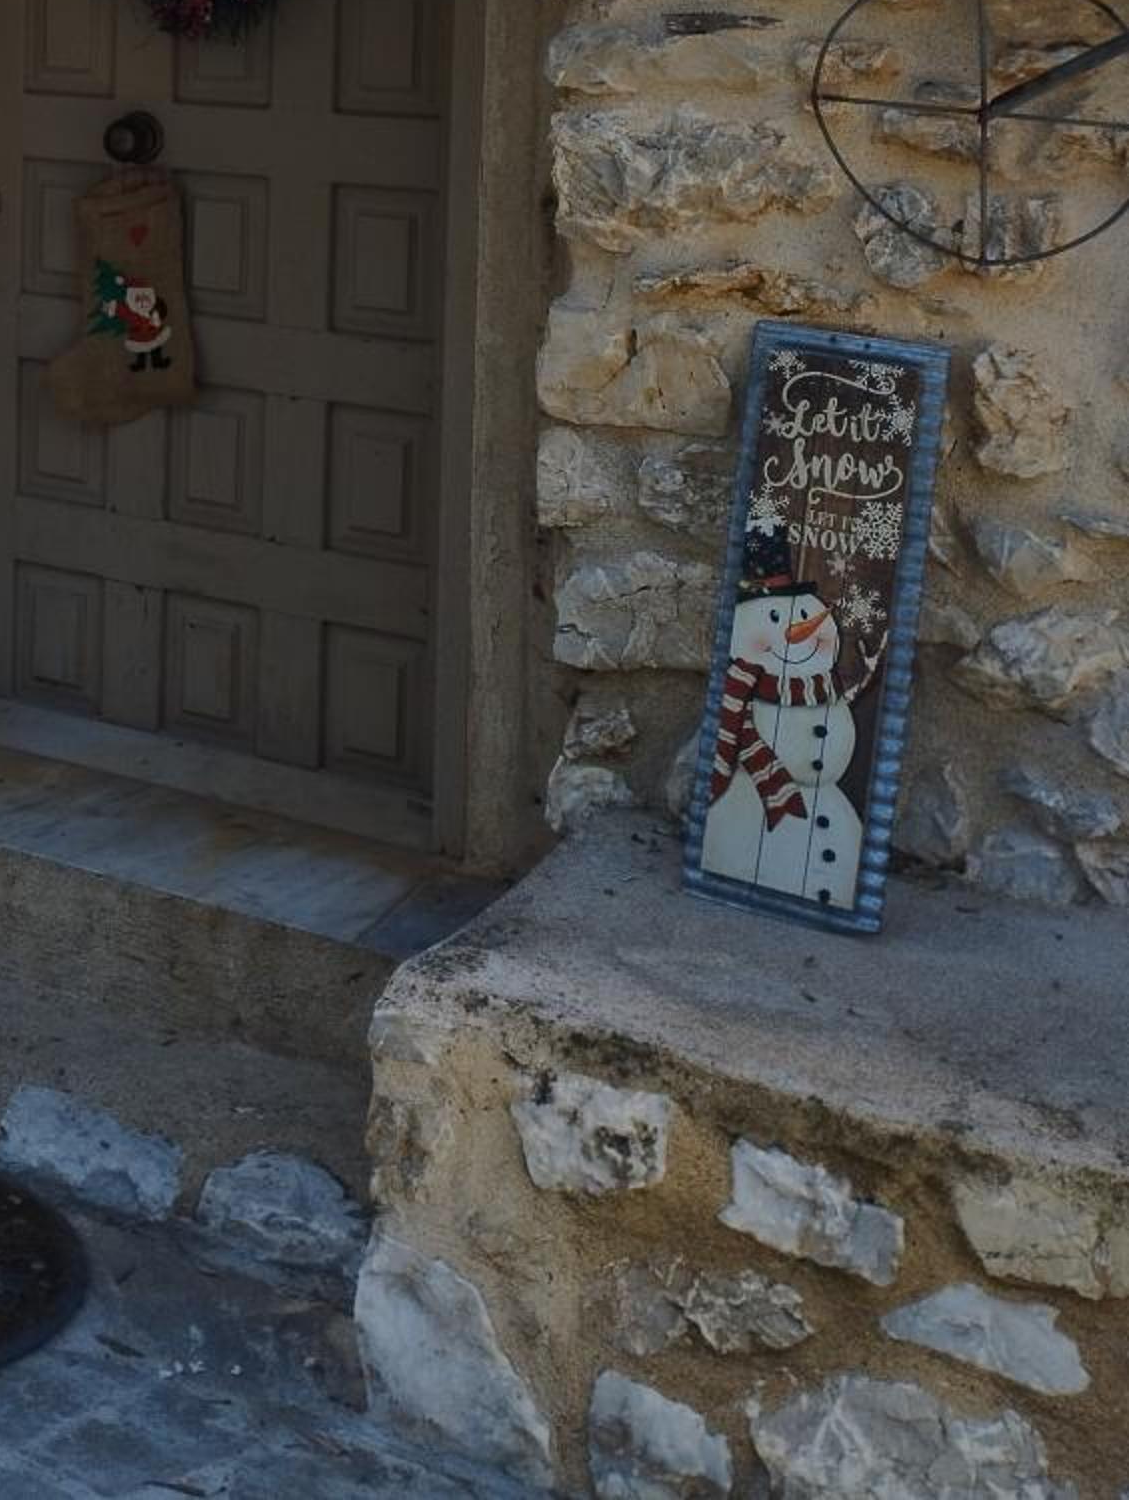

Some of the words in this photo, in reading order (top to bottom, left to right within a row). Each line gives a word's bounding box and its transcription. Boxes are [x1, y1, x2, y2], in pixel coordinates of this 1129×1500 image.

[781, 371, 848, 439] Let
[850, 402, 880, 443] it
[764, 438, 903, 500] Snow
[788, 523, 861, 555] SNOW
[807, 510, 837, 528] LET
